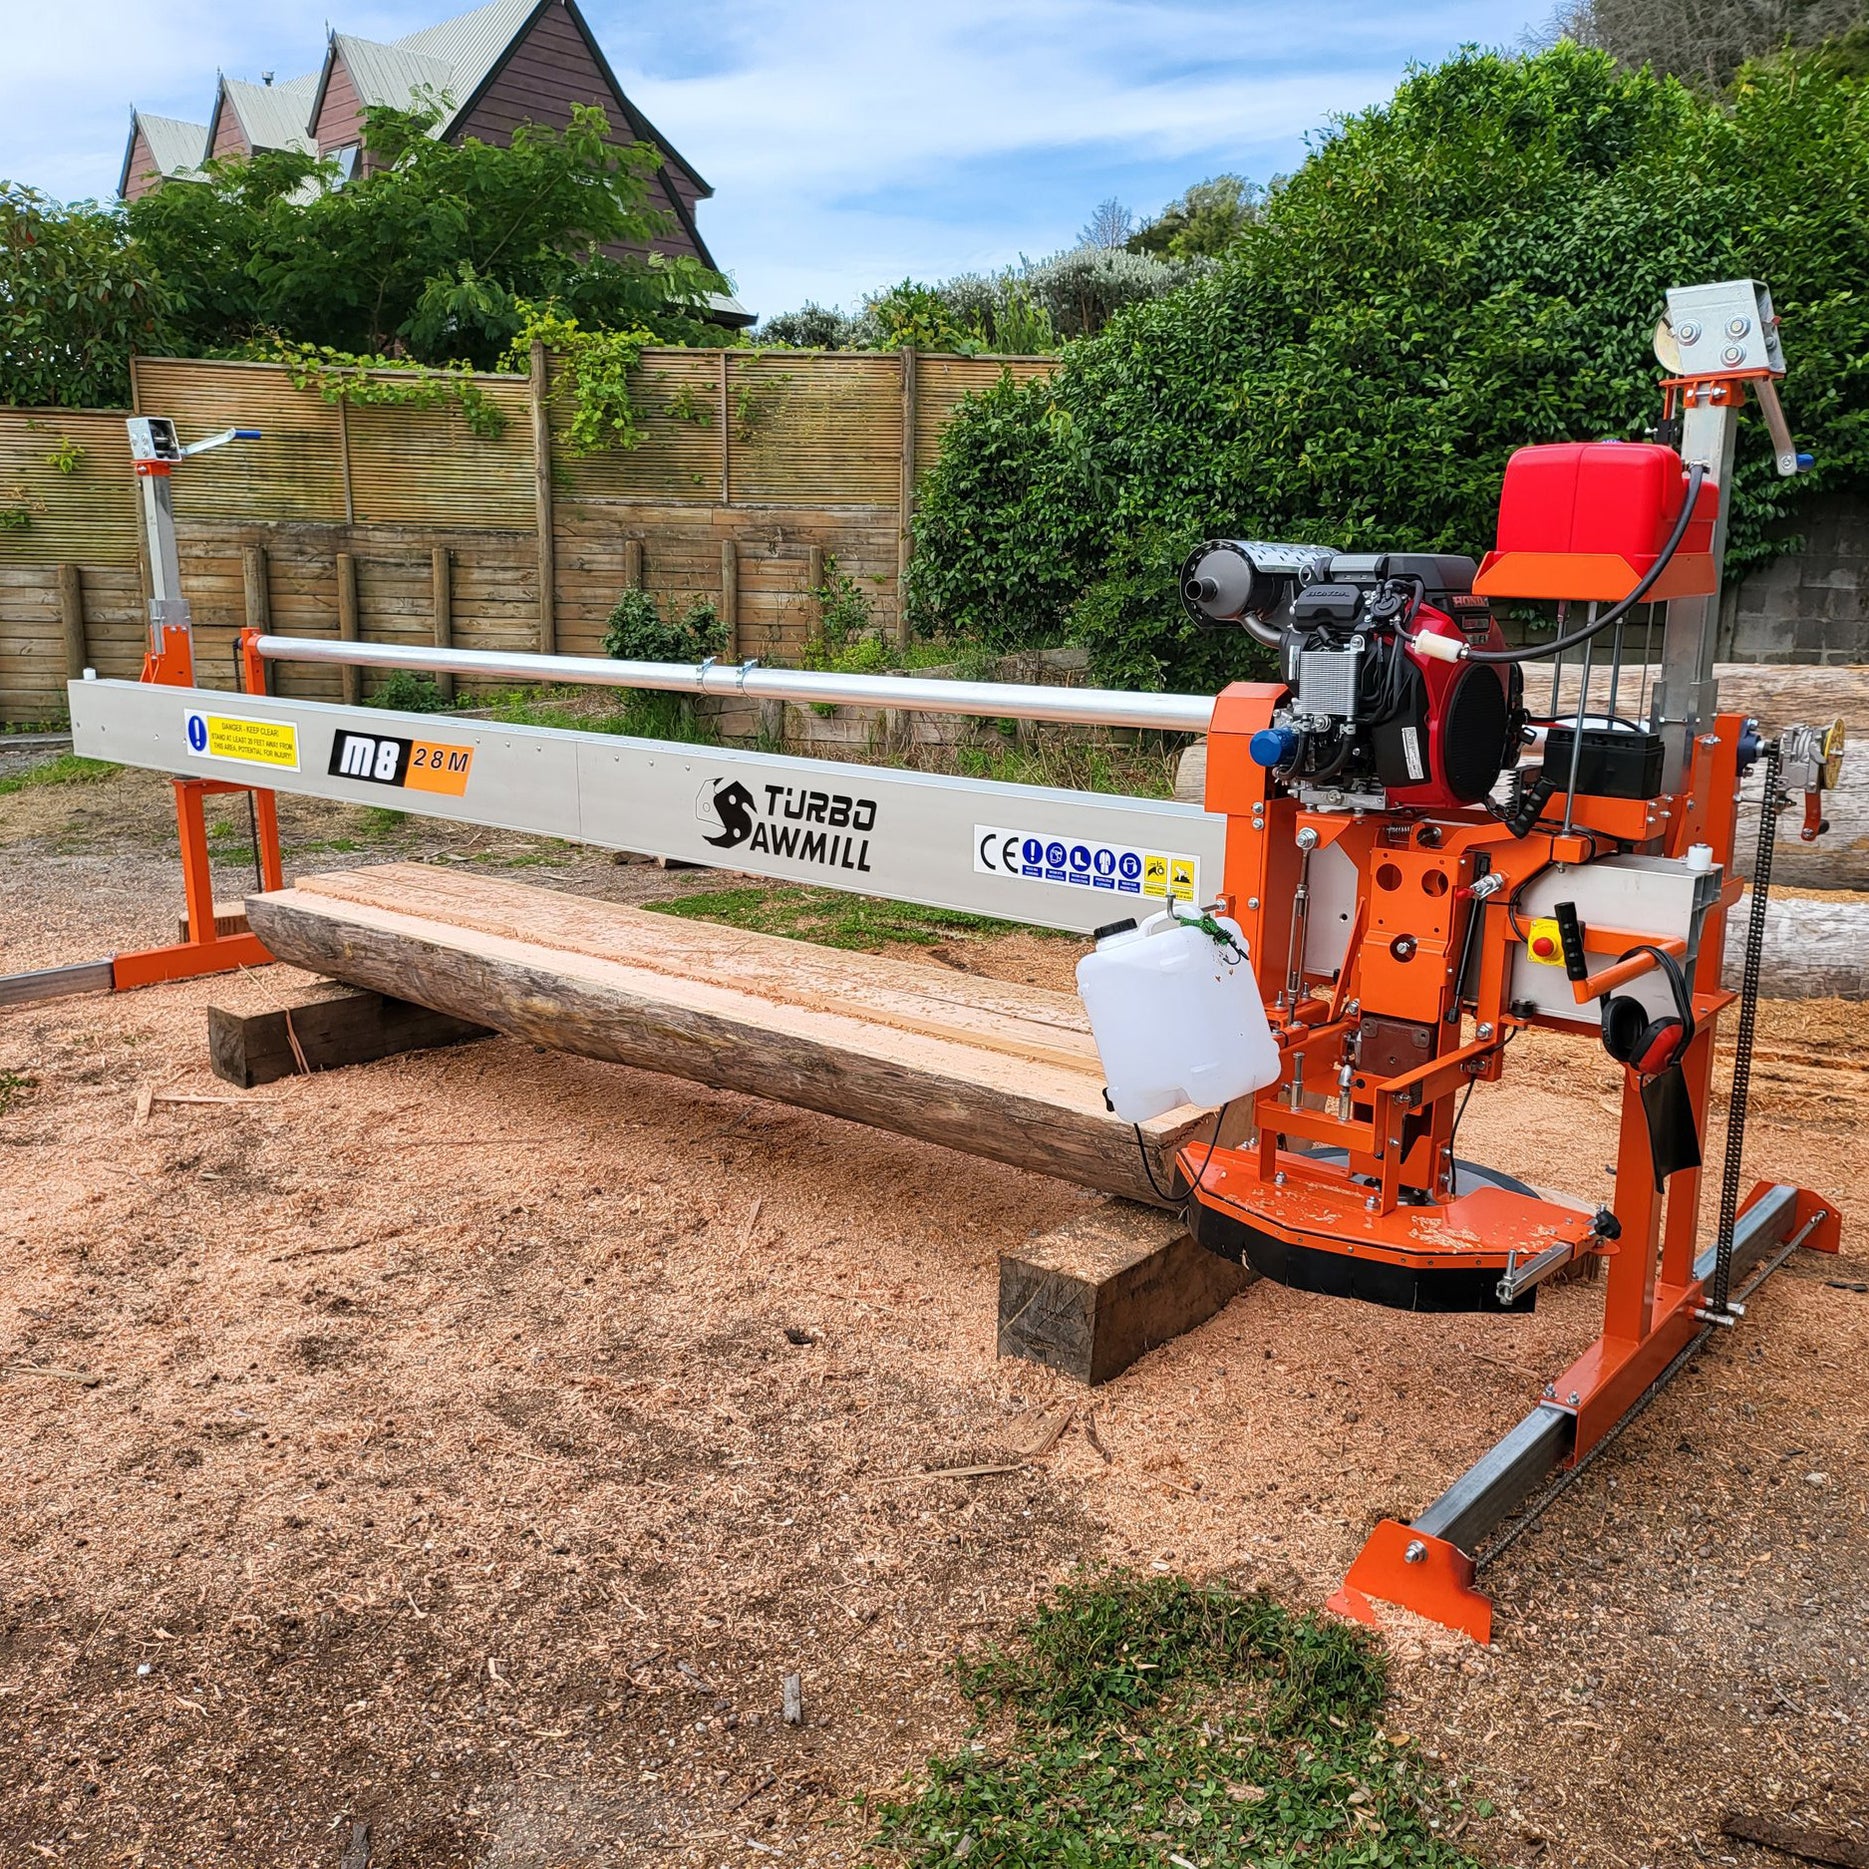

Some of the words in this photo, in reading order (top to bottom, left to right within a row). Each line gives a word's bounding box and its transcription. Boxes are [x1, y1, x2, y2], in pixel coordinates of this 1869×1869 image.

[221, 722, 242, 732] DANGER
[246, 726, 259, 735] KEEP
[211, 732, 225, 741] STAND
[226, 734, 232, 742] AT
[233, 735, 246, 744] LEAST
[254, 738, 265, 747] FEET
[279, 742, 293, 751] FROM
[263, 748, 273, 757] FOR
[765, 784, 878, 832] TURBO
[980, 833, 1019, 874] CE
